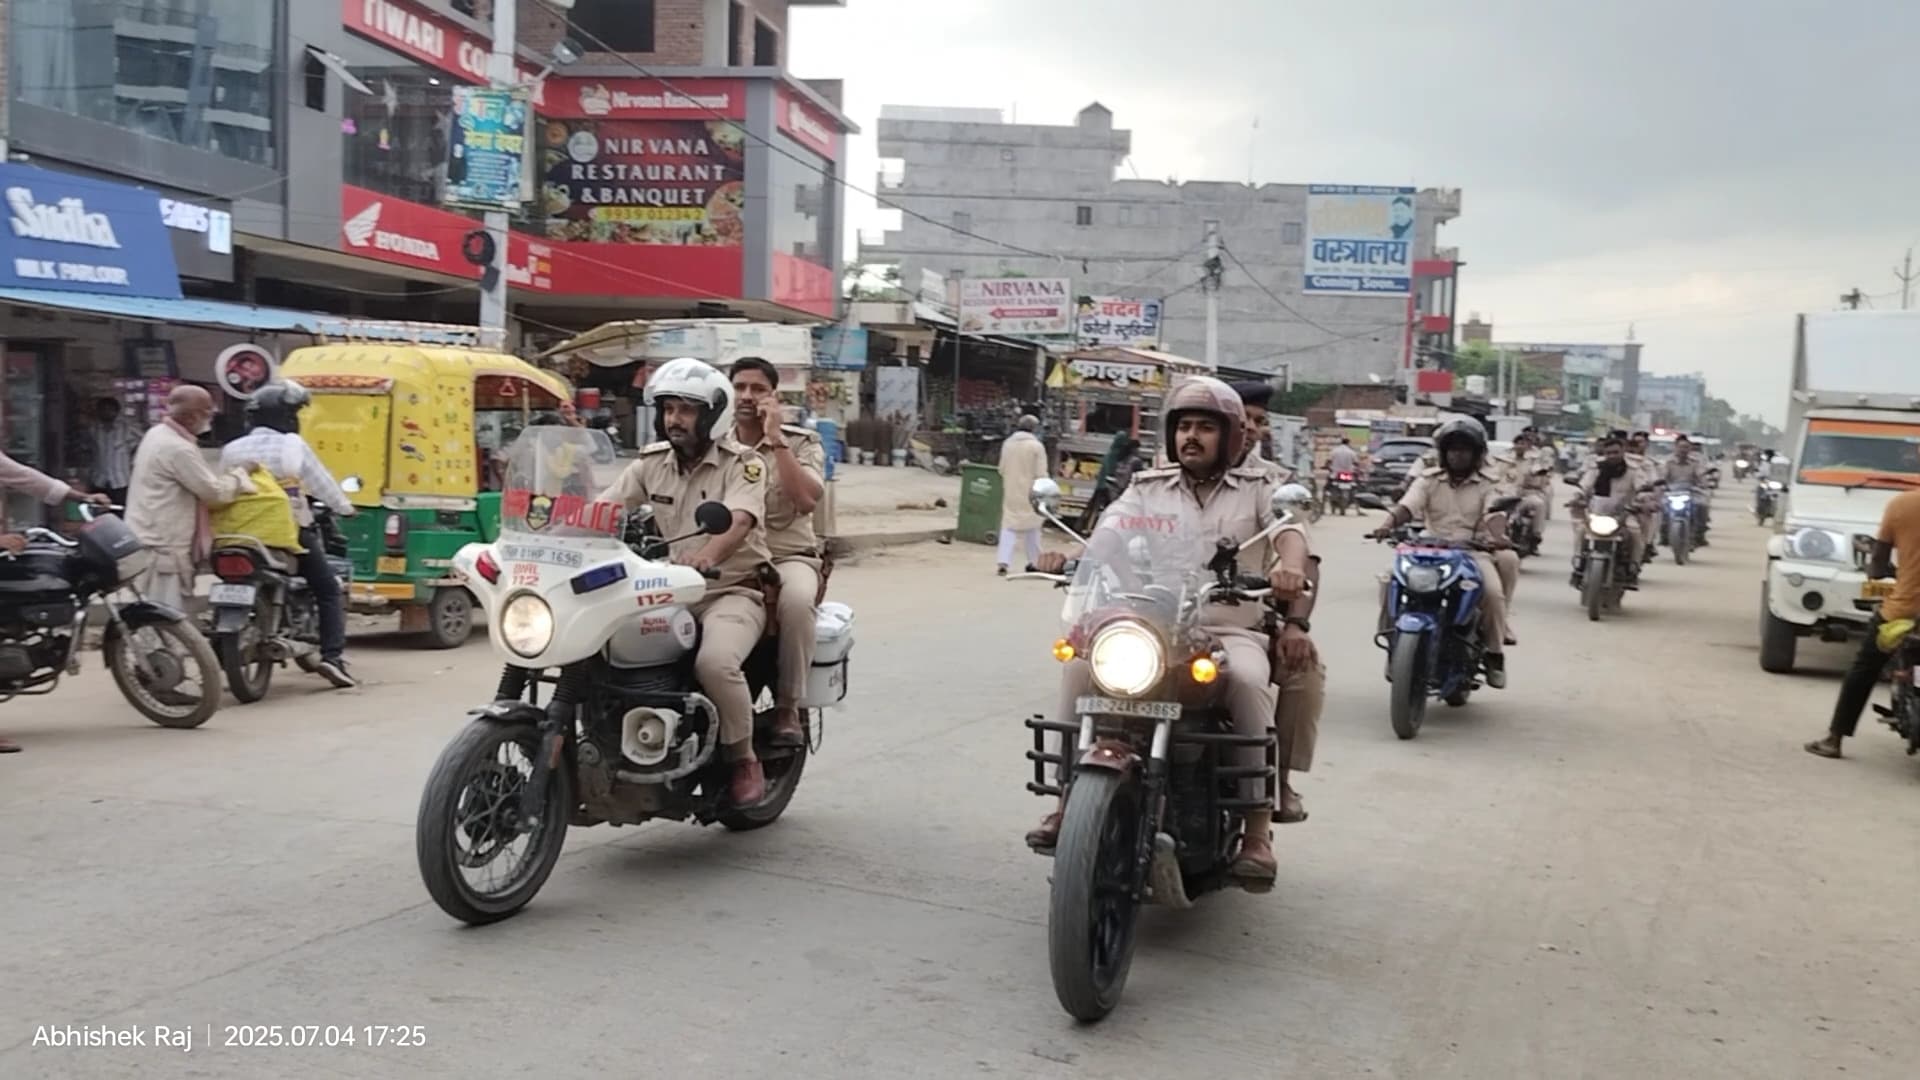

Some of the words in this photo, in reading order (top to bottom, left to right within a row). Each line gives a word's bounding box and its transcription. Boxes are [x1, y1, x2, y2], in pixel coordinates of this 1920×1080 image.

[605, 138, 709, 155] NIRVANA
[572, 164, 726, 181] RESTAURANT
[6, 187, 122, 248] Sudha
[1311, 238, 1408, 265] वस्त्रालय
[981, 281, 1065, 296] NIRVANA
[1311, 276, 1360, 291] Coming
[552, 495, 623, 534] POLICE
[512, 575, 539, 587] 112
[634, 577, 673, 591] DIAL
[637, 593, 674, 606] 112
